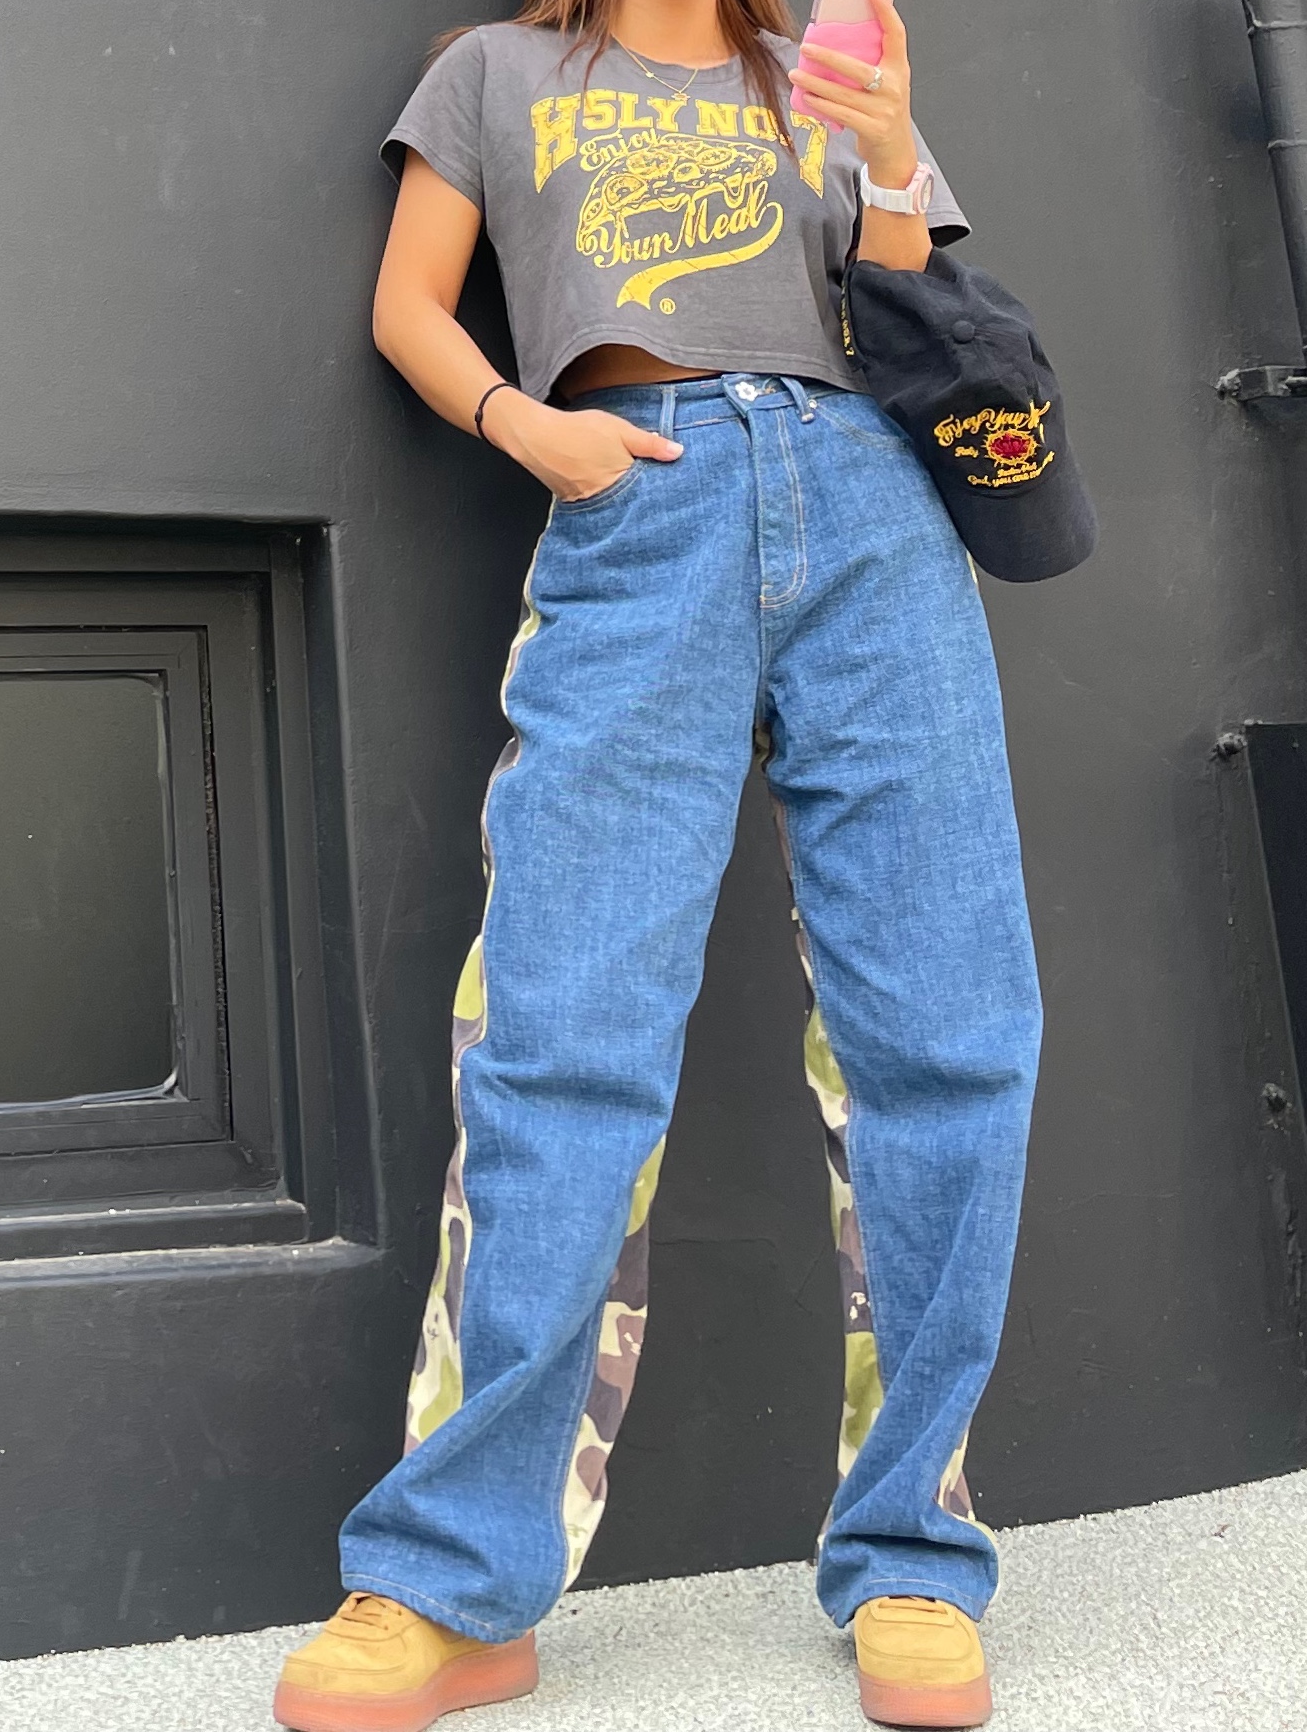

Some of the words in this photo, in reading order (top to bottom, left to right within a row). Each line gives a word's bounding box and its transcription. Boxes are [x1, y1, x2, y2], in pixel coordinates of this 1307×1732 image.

[579, 128, 661, 172] Enjoy
[790, 110, 829, 199] 7
[582, 211, 677, 269] Your
[673, 180, 770, 249] Meal
[933, 413, 981, 447] Enjoy
